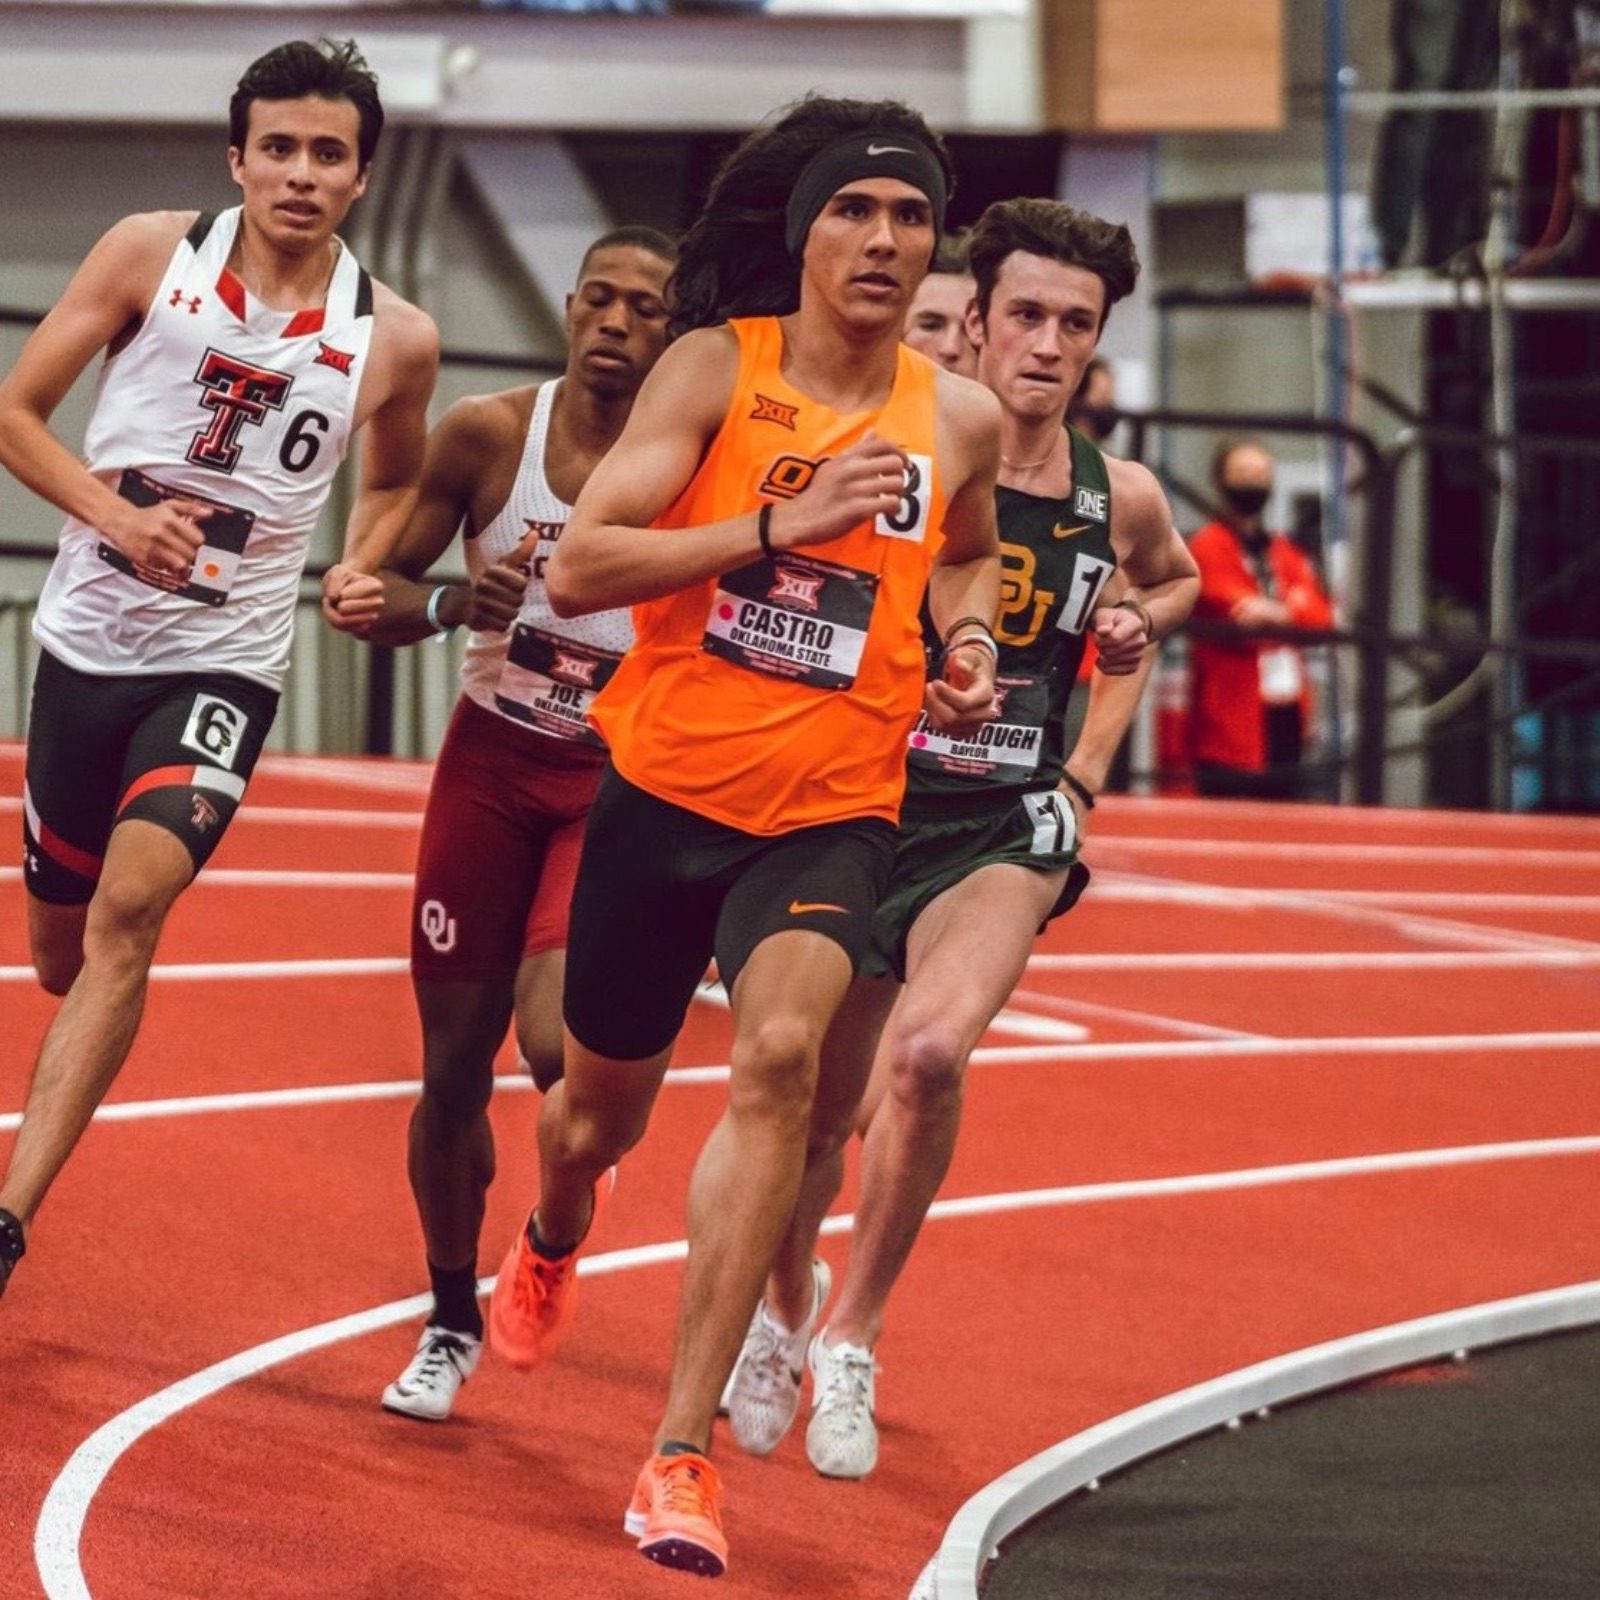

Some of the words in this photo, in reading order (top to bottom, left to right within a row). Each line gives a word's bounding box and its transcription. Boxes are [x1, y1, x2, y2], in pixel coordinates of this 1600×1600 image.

[279, 409, 330, 473] 6
[1077, 489, 1106, 516] ONE
[993, 541, 1055, 648] BU
[1074, 565, 1105, 631] 1
[729, 627, 796, 660] OKLAHOMA
[795, 648, 832, 668] STATE
[738, 602, 835, 650] CASTRO
[547, 682, 586, 709] JOE
[195, 701, 238, 756] 6
[950, 744, 990, 760] BAYLOR
[421, 899, 456, 952] OU
